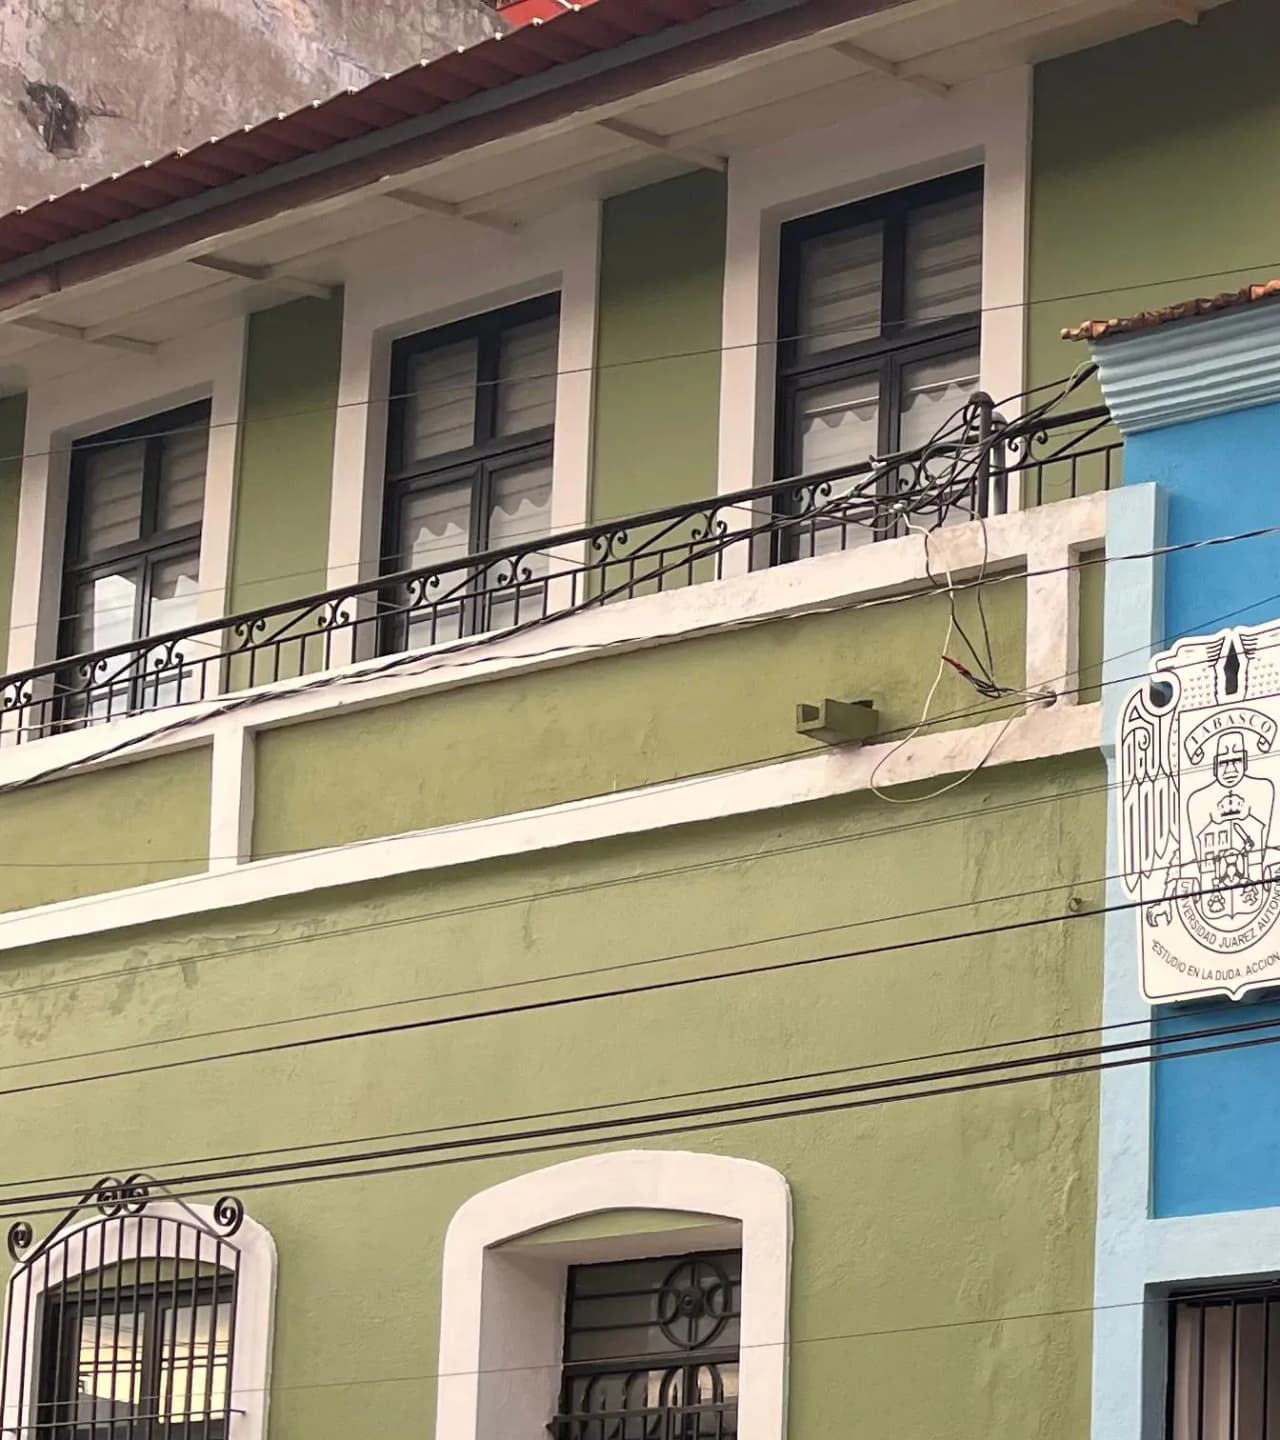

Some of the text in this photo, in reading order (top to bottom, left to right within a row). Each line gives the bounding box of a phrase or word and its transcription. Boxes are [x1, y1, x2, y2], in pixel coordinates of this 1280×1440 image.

[1190, 711, 1272, 745] TABASCO
[1219, 928, 1258, 948] JUAREZ
[1187, 965, 1200, 978] EN
[1201, 969, 1214, 980] LA
